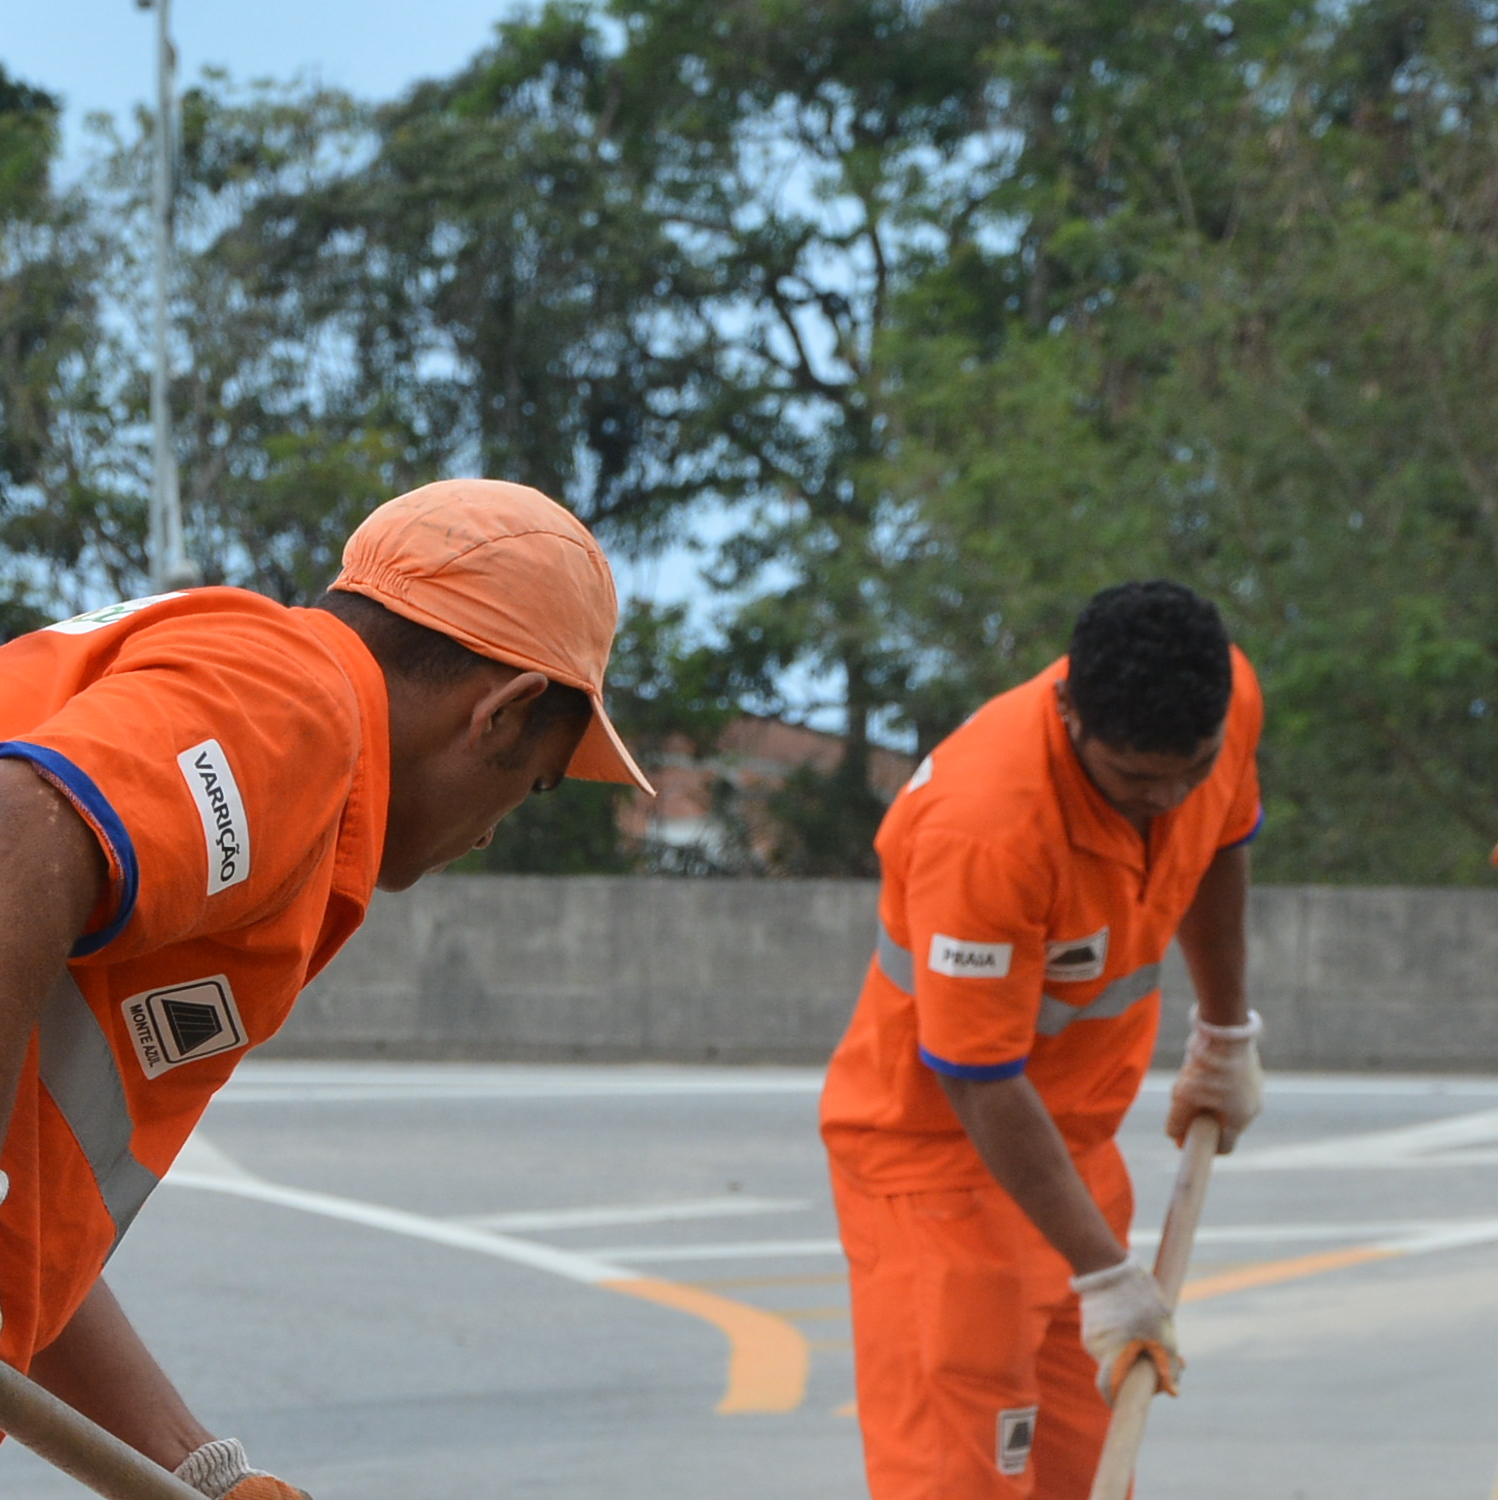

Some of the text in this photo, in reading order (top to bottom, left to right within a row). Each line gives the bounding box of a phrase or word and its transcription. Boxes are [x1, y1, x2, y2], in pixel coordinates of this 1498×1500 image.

[194, 750, 240, 882] VARRIÇÃO
[943, 949, 996, 967] PRAIA
[129, 1003, 161, 1068] MONTE AZUL
